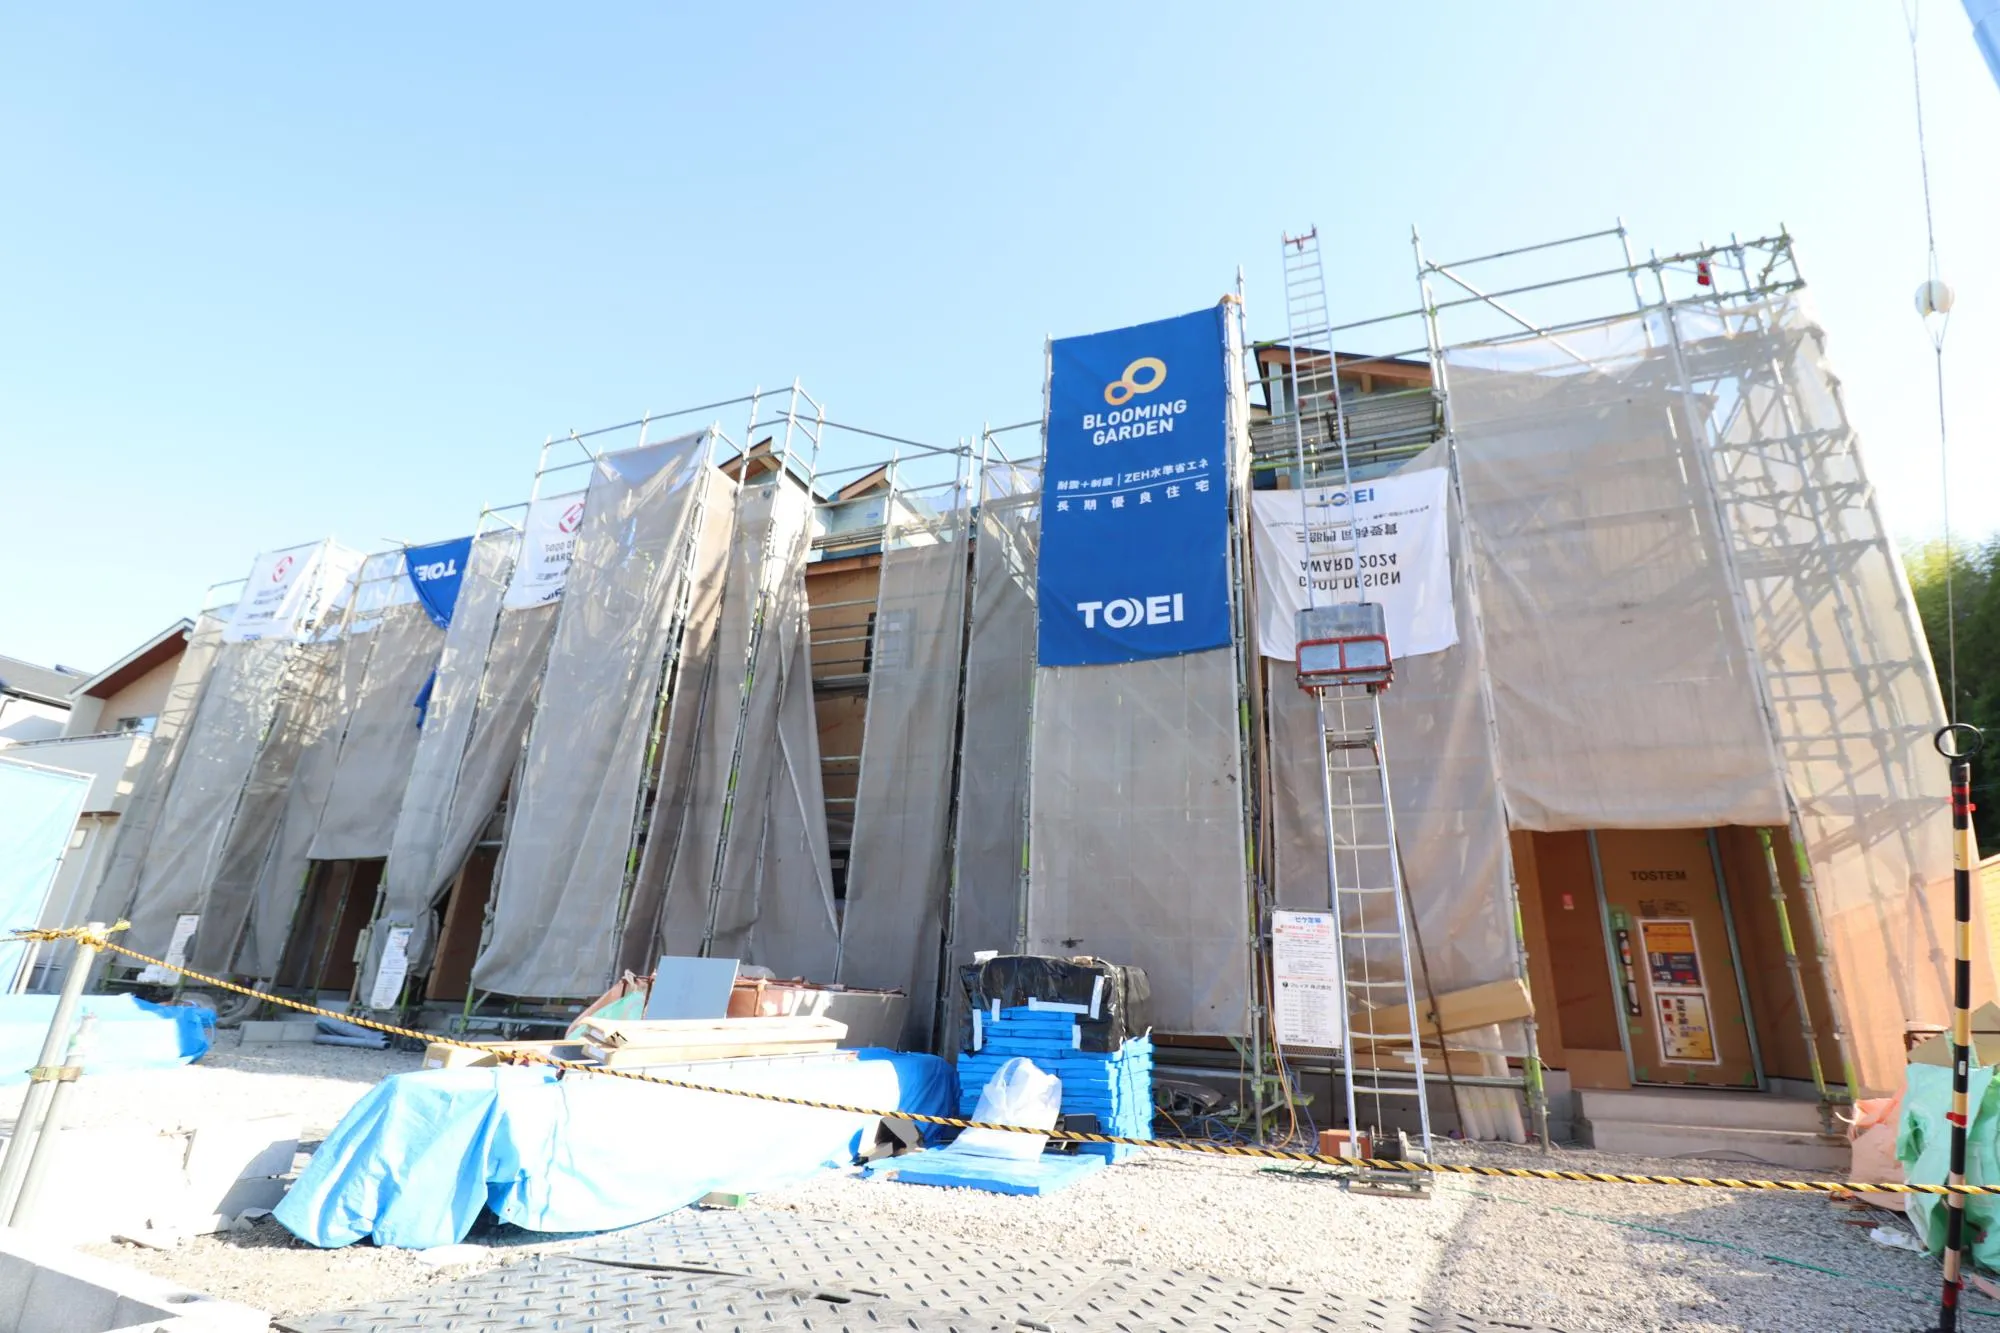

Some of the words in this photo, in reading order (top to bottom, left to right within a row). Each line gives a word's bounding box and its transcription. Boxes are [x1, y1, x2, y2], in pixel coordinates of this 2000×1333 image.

[1083, 399, 1187, 431] BLOOMING
[1092, 417, 1174, 446] GARDEN
[1124, 458, 1209, 484] ZEH水準省エネ
[414, 558, 457, 582] TOE
[1076, 592, 1184, 629] TOEI
[1629, 869, 1687, 881] TOSTEM
